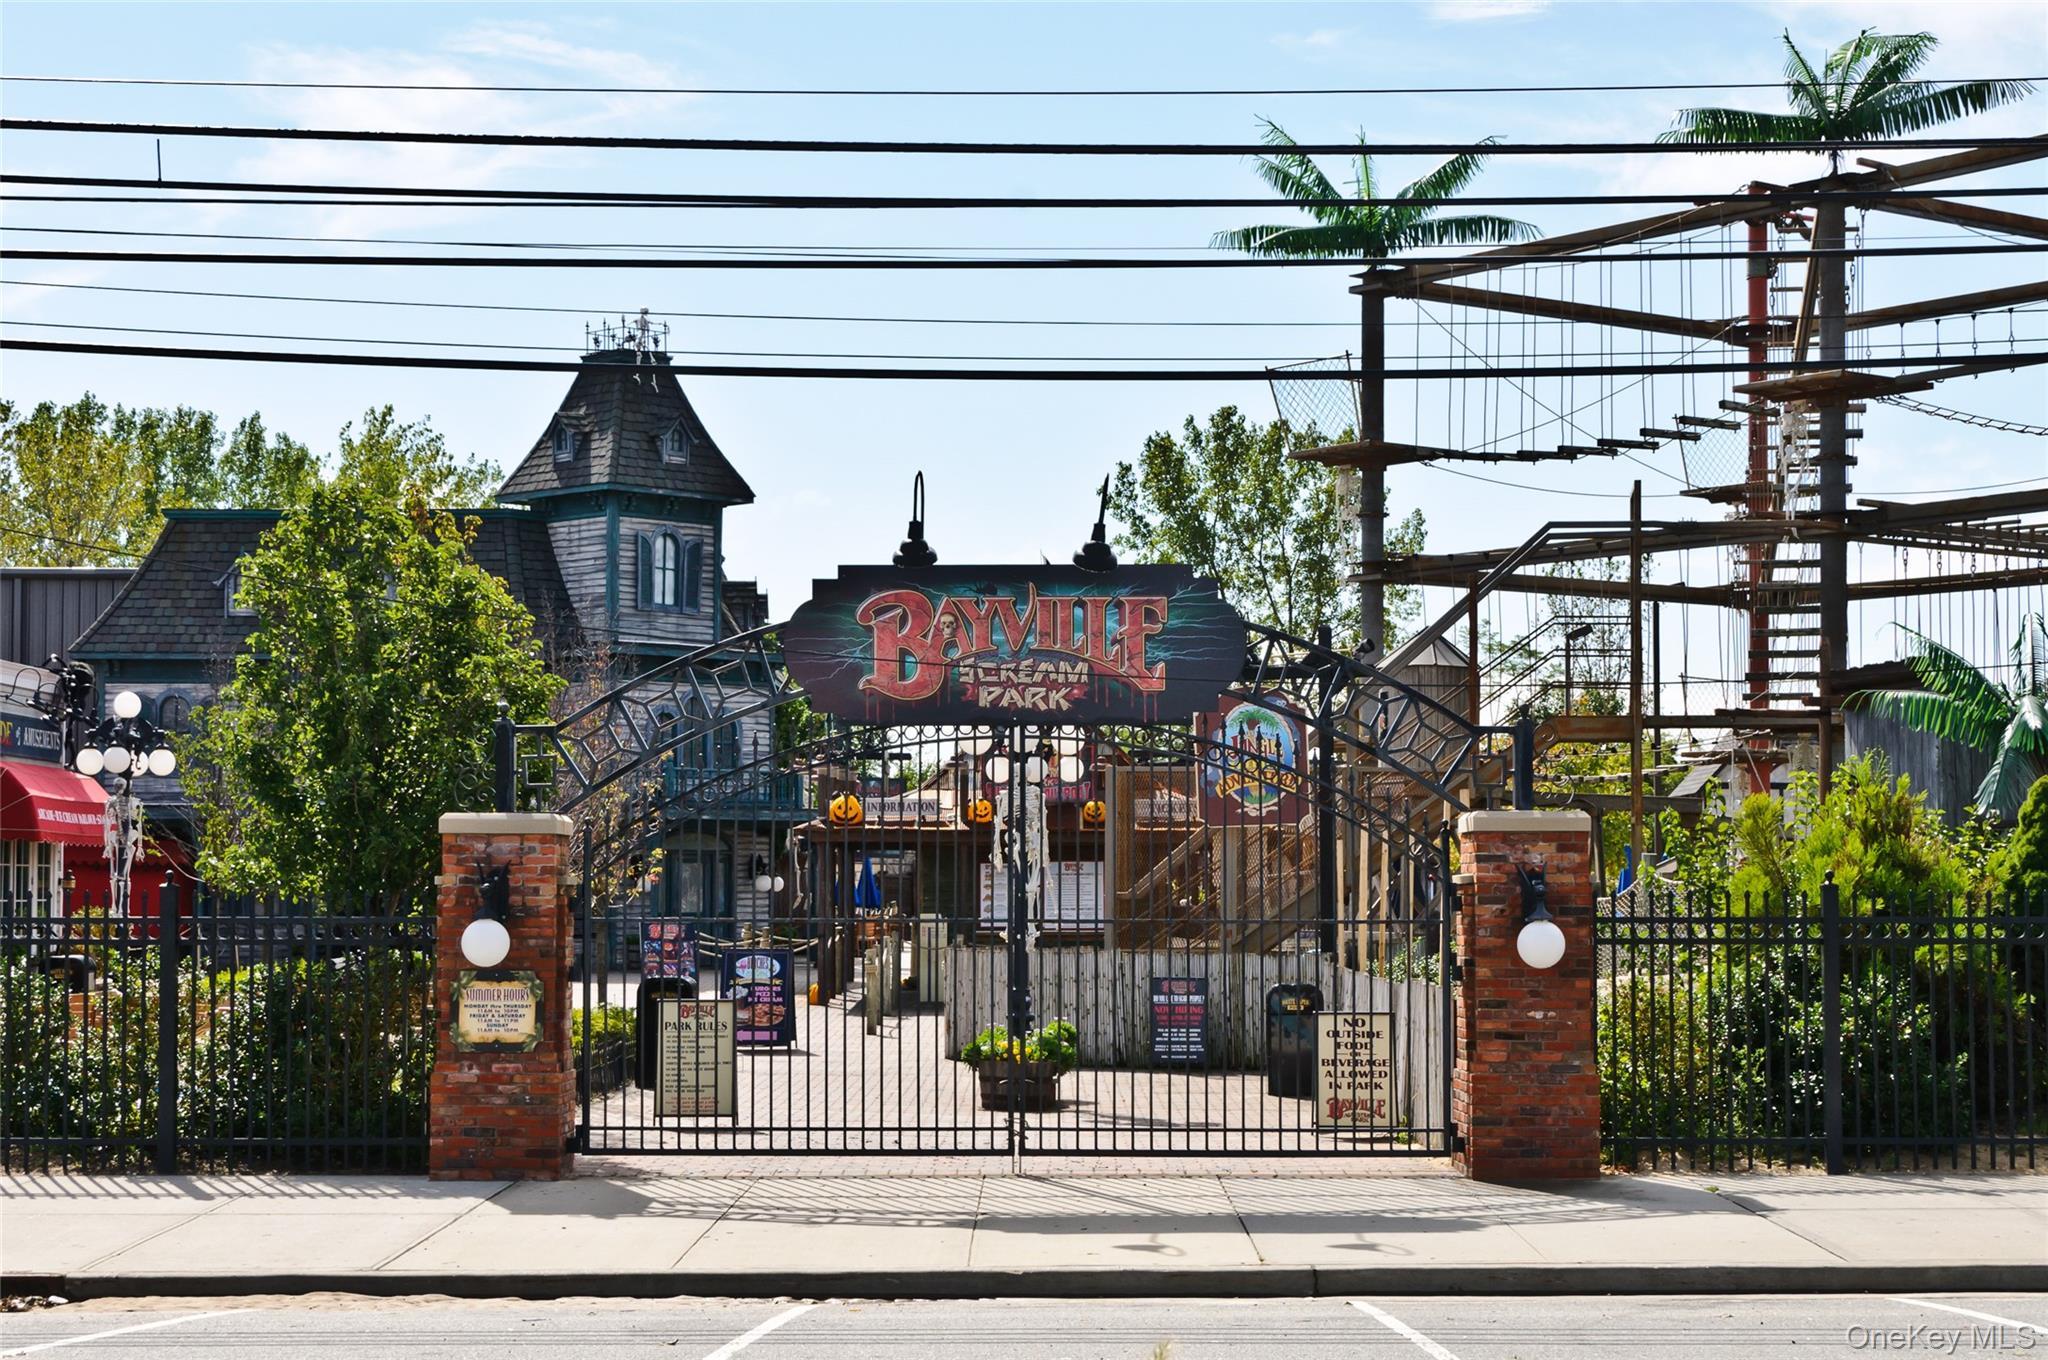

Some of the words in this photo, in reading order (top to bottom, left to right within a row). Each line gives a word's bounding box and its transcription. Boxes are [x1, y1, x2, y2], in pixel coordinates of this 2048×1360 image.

[856, 582, 1168, 701] BAYVILLE
[959, 656, 1089, 684] SCREAM
[977, 686, 1072, 712] PARK
[24, 727, 60, 750] AMUSEMENTS
[867, 801, 935, 812] INORATON
[466, 988, 502, 1001] SUMMER
[503, 988, 529, 1001] HOURS
[1175, 1005, 1204, 1014] HIING
[1343, 1017, 1366, 1028] NO
[1326, 1030, 1384, 1039] OUTSIDE
[1336, 1041, 1373, 1050] FOOD
[1321, 1058, 1390, 1067] BEVERAGE
[1324, 1070, 1388, 1079] ALLOWED
[1328, 1081, 1342, 1090] IN
[1347, 1081, 1384, 1090] PARK
